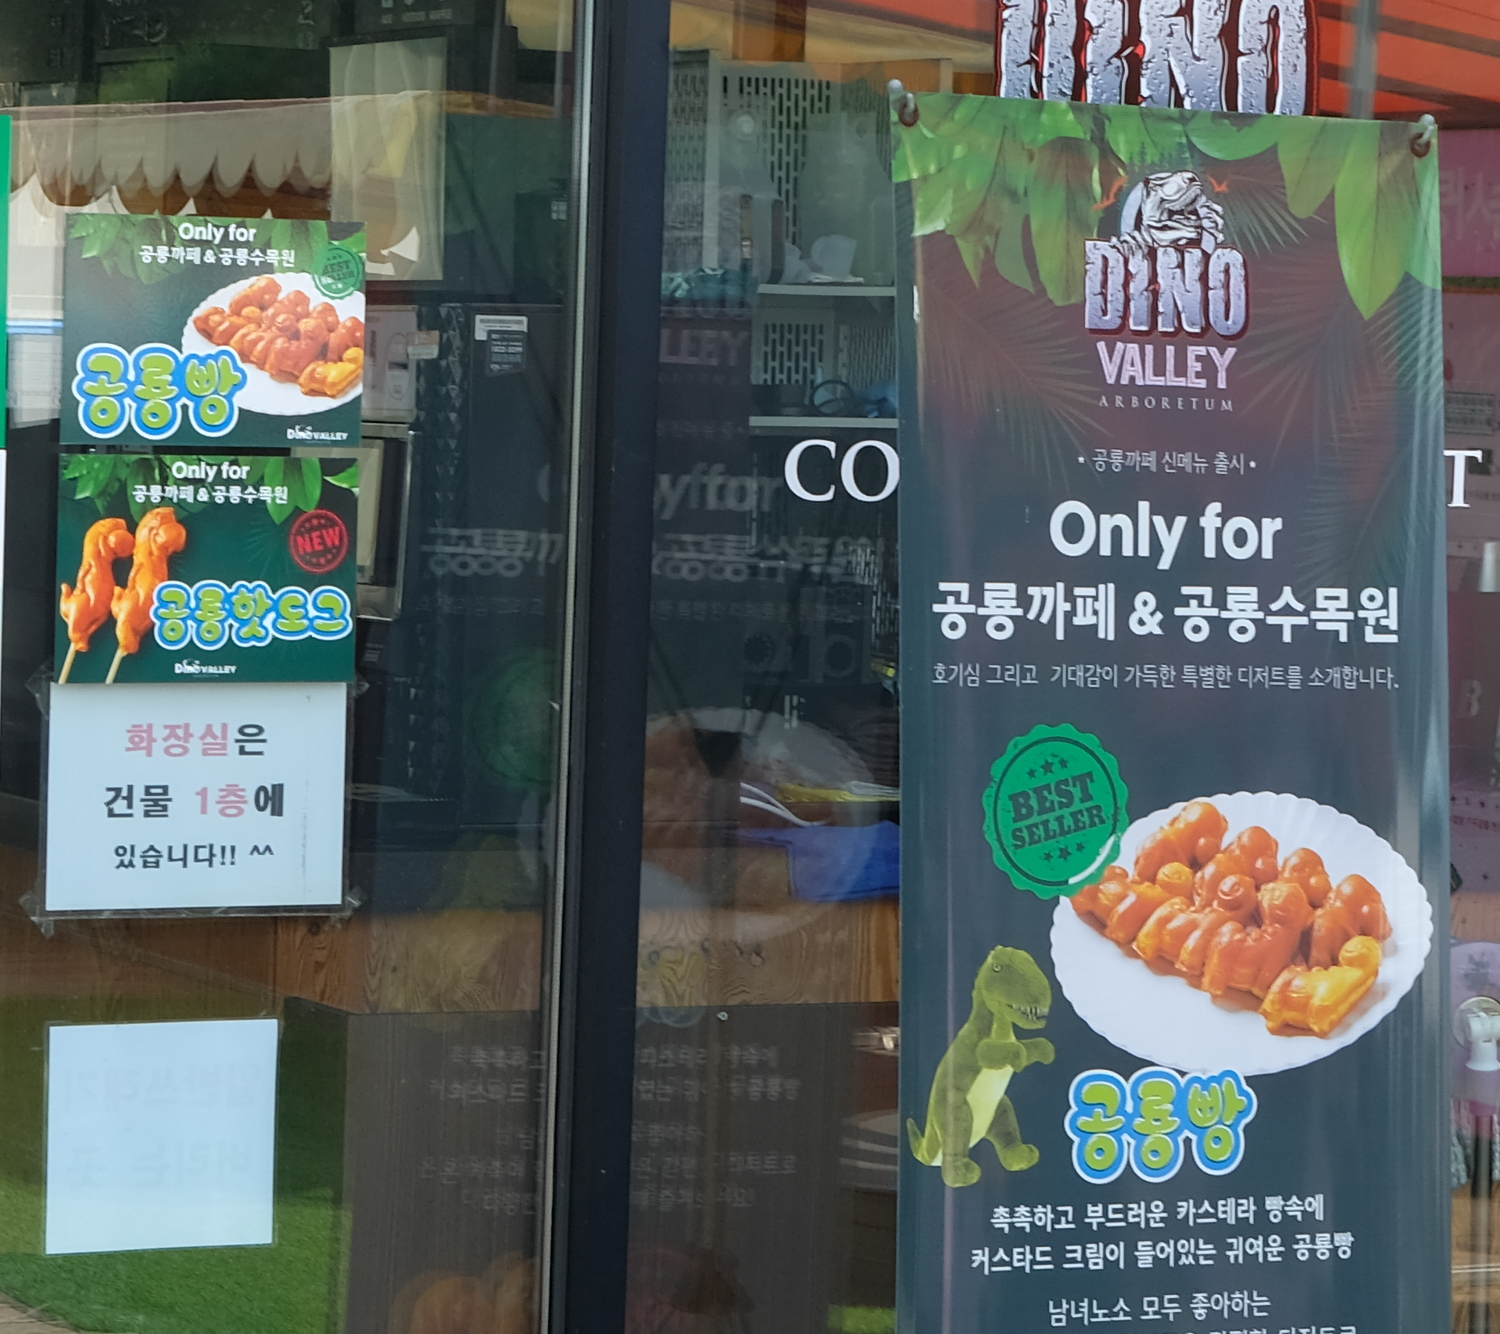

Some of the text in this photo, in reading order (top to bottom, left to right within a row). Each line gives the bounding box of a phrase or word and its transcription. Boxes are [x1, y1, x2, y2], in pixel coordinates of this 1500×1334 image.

[178, 222, 257, 243] Only for
[139, 245, 295, 268] 공룡까페 & 공룡수목원
[1084, 238, 1249, 336] DINO
[1097, 341, 1237, 390] VALLEY
[76, 347, 243, 436] 공룡빵
[1100, 395, 1234, 411] ARBORETUM
[171, 461, 249, 482] Only for
[1092, 450, 1245, 474] 공룡까페 신메뉴 출시
[132, 485, 288, 505] 공룡까페 & 공룡수목원
[296, 527, 341, 553] NEW
[1050, 500, 1282, 569] Only for
[154, 585, 349, 645] 공룡핫도그
[933, 582, 1398, 642] 공룡까페 & 공룡수목원
[932, 663, 1399, 690] 호기심 그리고 기대감이 가득한 특별한 디저트를 소개합니다.
[126, 723, 267, 757] 화장실은
[104, 783, 285, 818] 건물 1층에
[1008, 771, 1096, 823] BEST
[1011, 804, 1108, 850] SELLER
[114, 844, 235, 869] 있습니다!!
[1069, 1071, 1252, 1177] 공룡빵
[990, 1194, 1323, 1233] 촉촉하고 부드러운 카스테라 빵속에
[972, 1232, 1354, 1275] 커스타드 크림이 들어있는 귀여운 공룡빵
